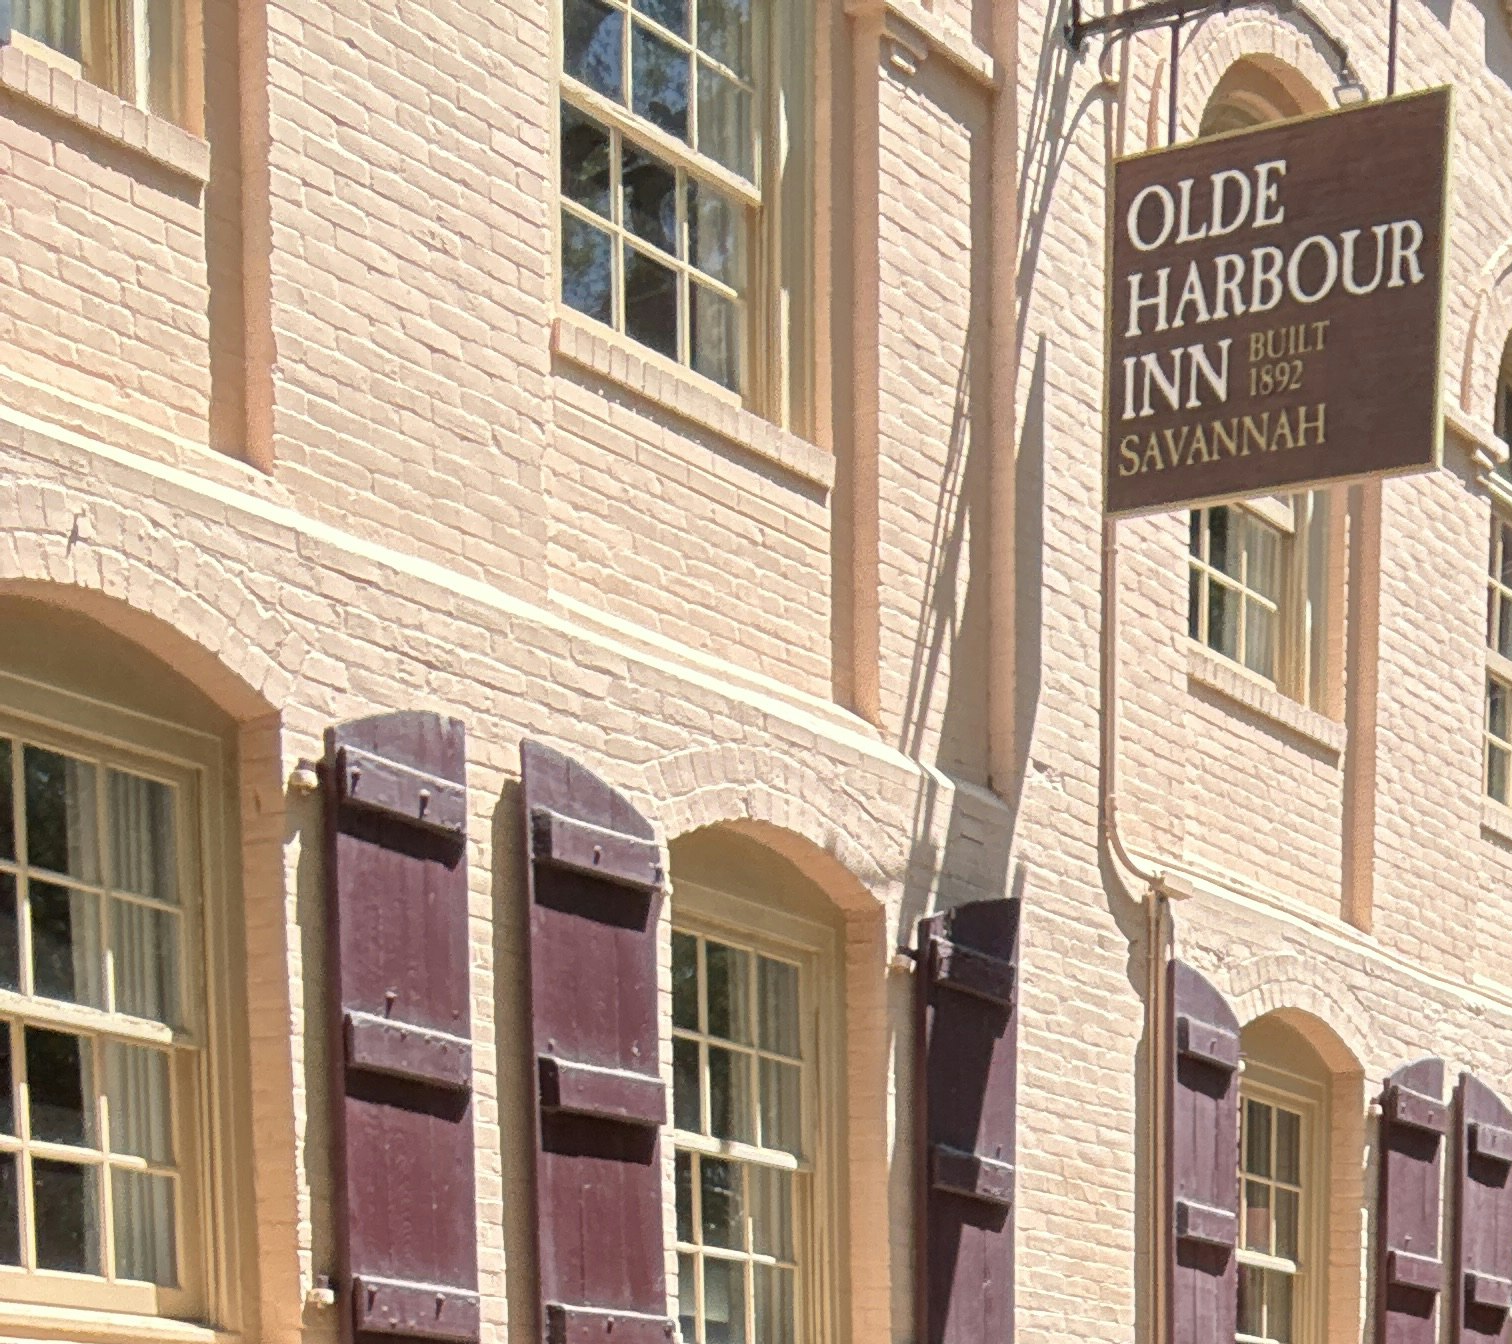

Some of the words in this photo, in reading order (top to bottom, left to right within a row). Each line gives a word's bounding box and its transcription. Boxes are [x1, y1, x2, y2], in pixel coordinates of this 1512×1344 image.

[1127, 160, 1287, 252] OLDE
[1124, 219, 1425, 338] HARBOUR
[1121, 338, 1233, 421] INN
[1249, 320, 1330, 363] BUILT
[1249, 359, 1304, 397] 1892
[1118, 403, 1327, 477] SAVANNAH
